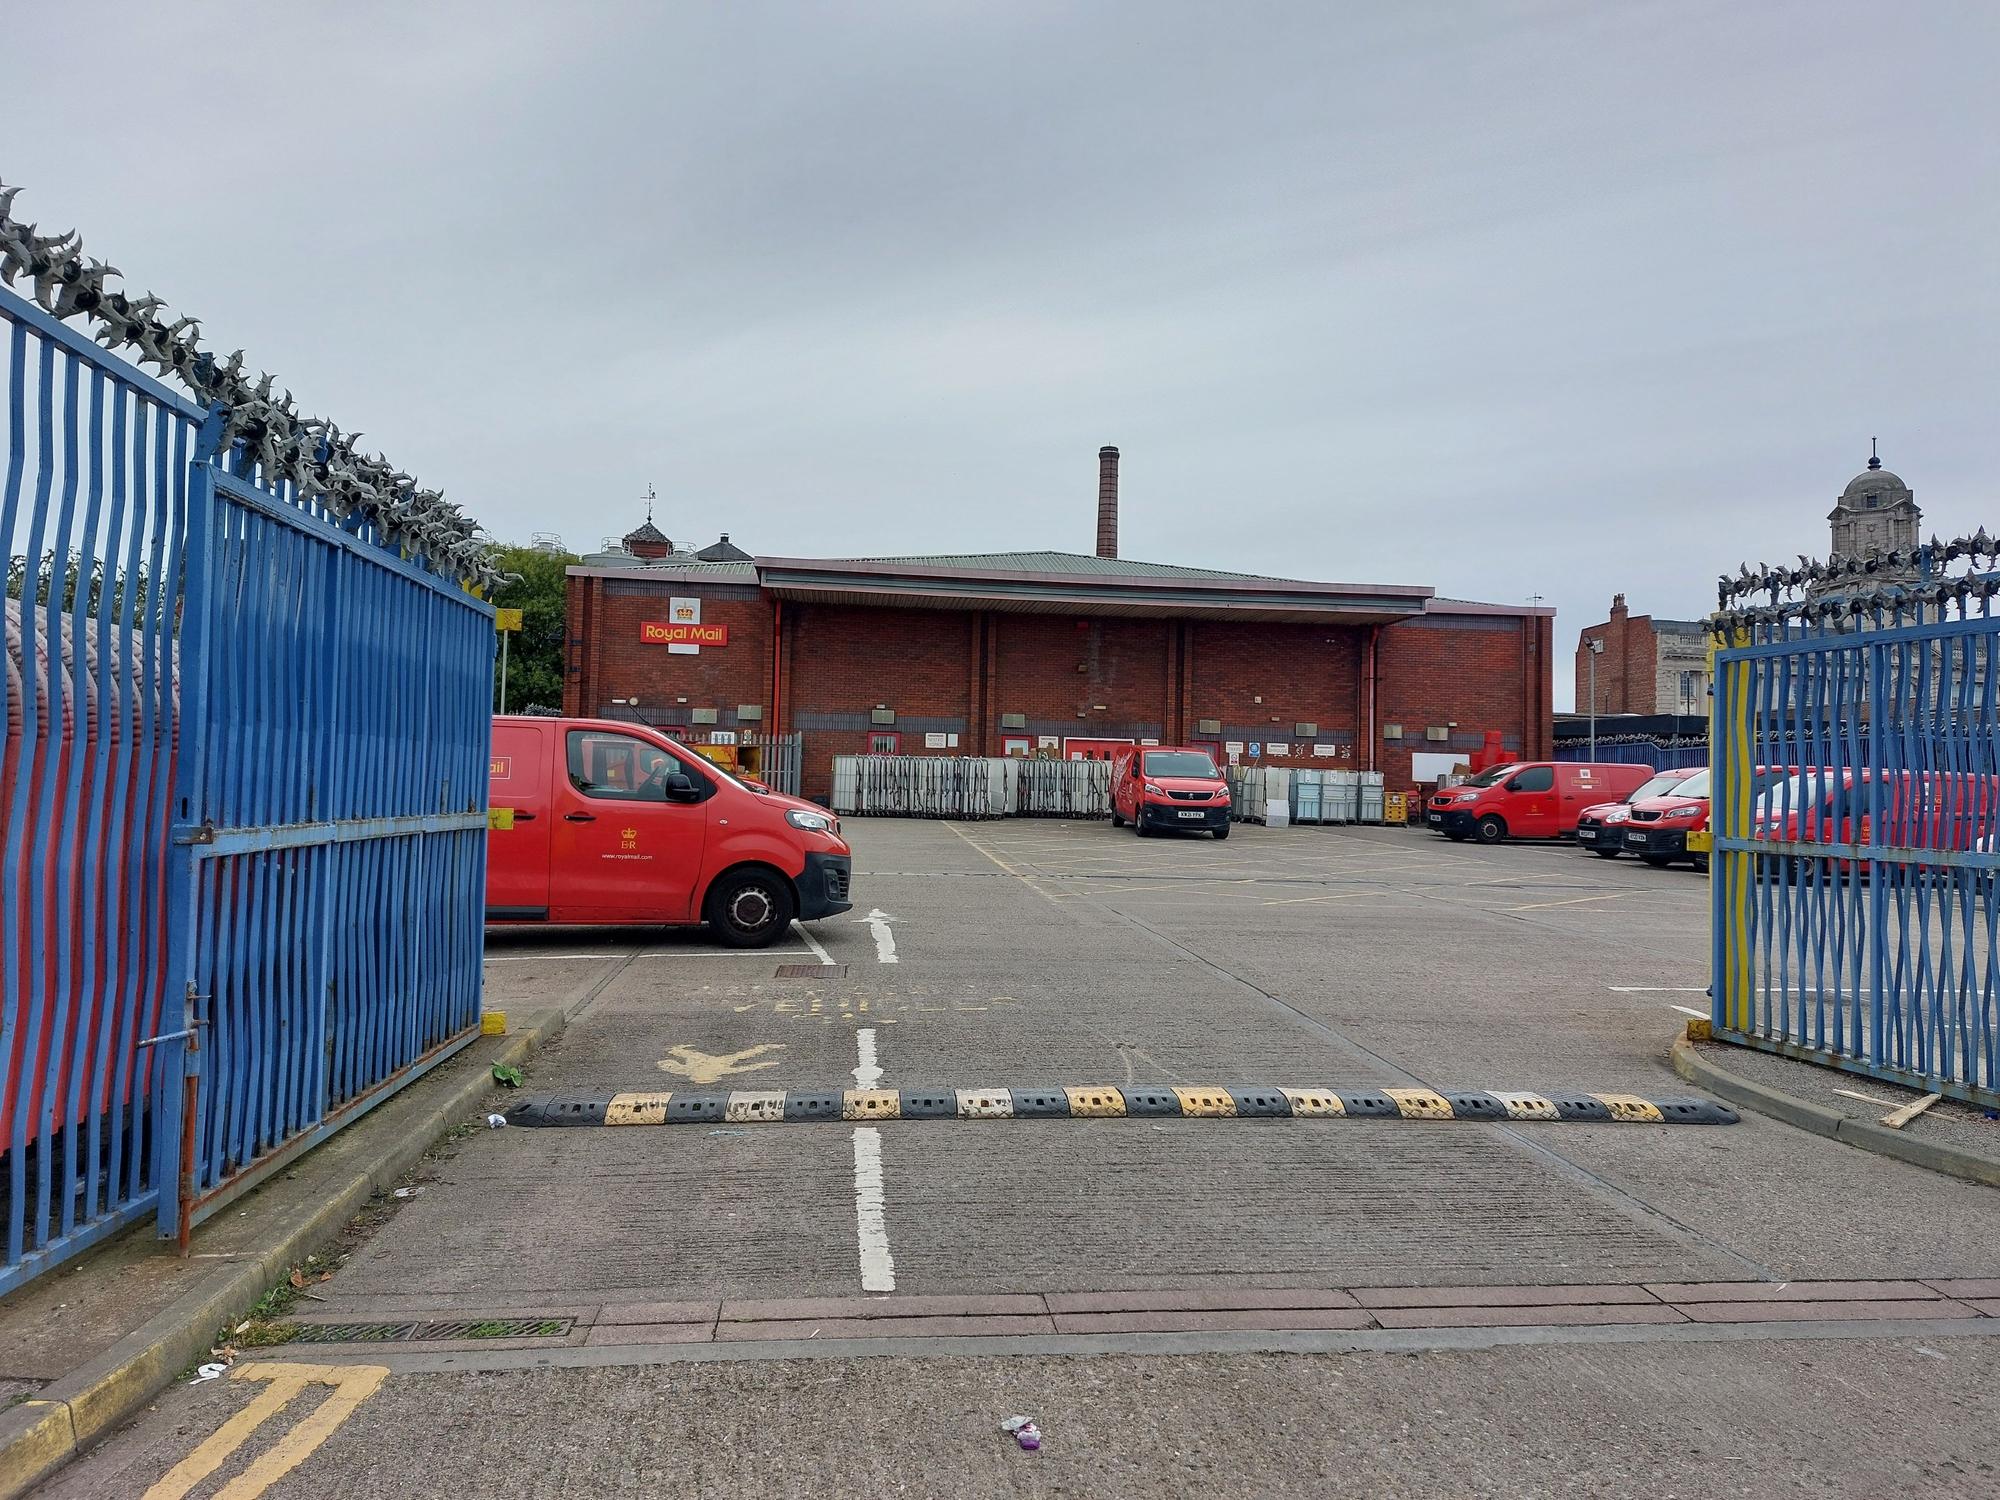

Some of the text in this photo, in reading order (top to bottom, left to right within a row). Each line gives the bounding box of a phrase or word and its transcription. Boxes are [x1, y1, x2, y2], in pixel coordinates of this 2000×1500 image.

[645, 625, 723, 641] Royal Mail
[490, 761, 504, 773] ail
